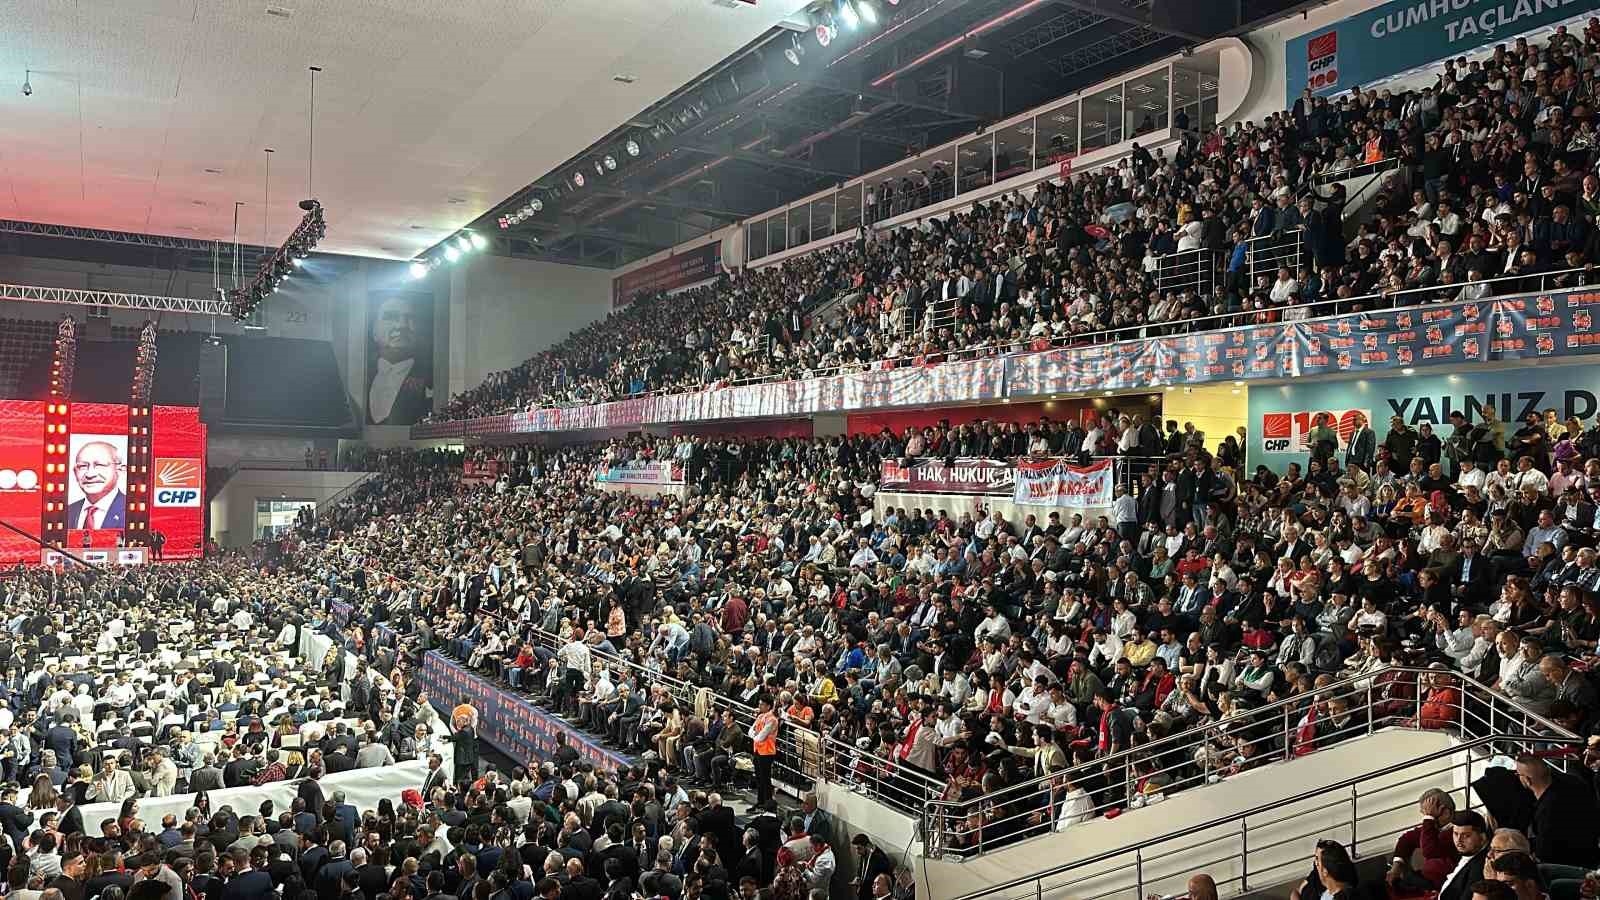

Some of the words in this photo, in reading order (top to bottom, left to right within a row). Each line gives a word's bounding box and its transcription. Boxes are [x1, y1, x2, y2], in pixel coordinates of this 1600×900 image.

[1370, 0, 1479, 38] CUMHU
[1444, 0, 1576, 42] TAÇLAN
[1311, 55, 1335, 71] CHP
[1387, 391, 1546, 424] YALNIZ
[1264, 440, 1290, 451] CHP
[917, 467, 947, 484] HAK,
[950, 467, 1000, 484] HUKUK,
[158, 490, 197, 503] CHP
